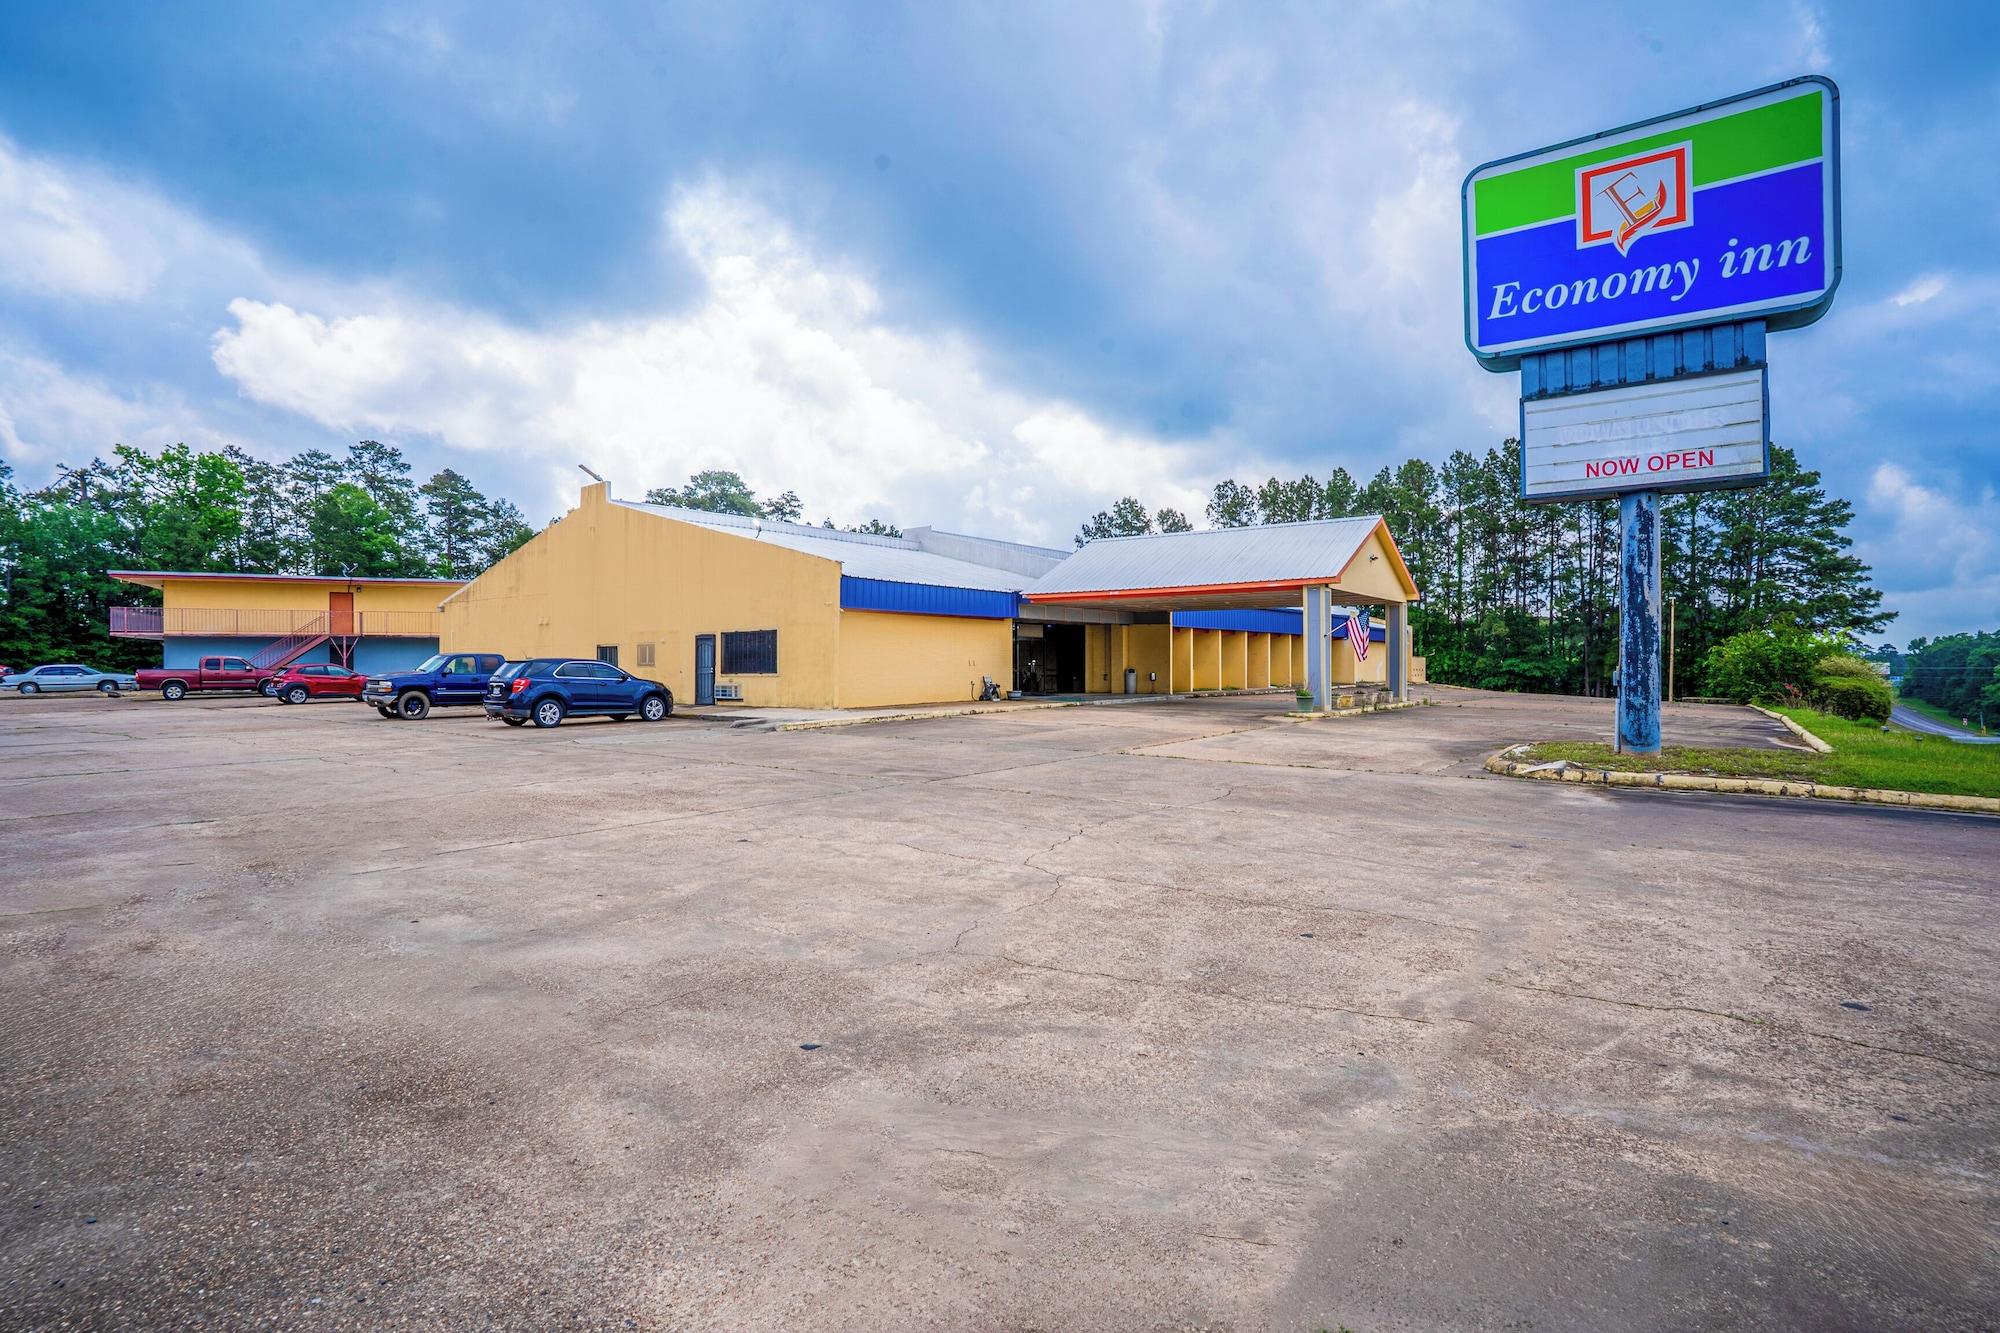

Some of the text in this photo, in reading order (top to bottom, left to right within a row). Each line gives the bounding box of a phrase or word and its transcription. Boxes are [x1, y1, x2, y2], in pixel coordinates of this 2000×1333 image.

[1487, 235, 1812, 320] Economy inn
[1586, 449, 1714, 478] NOW OPEN
